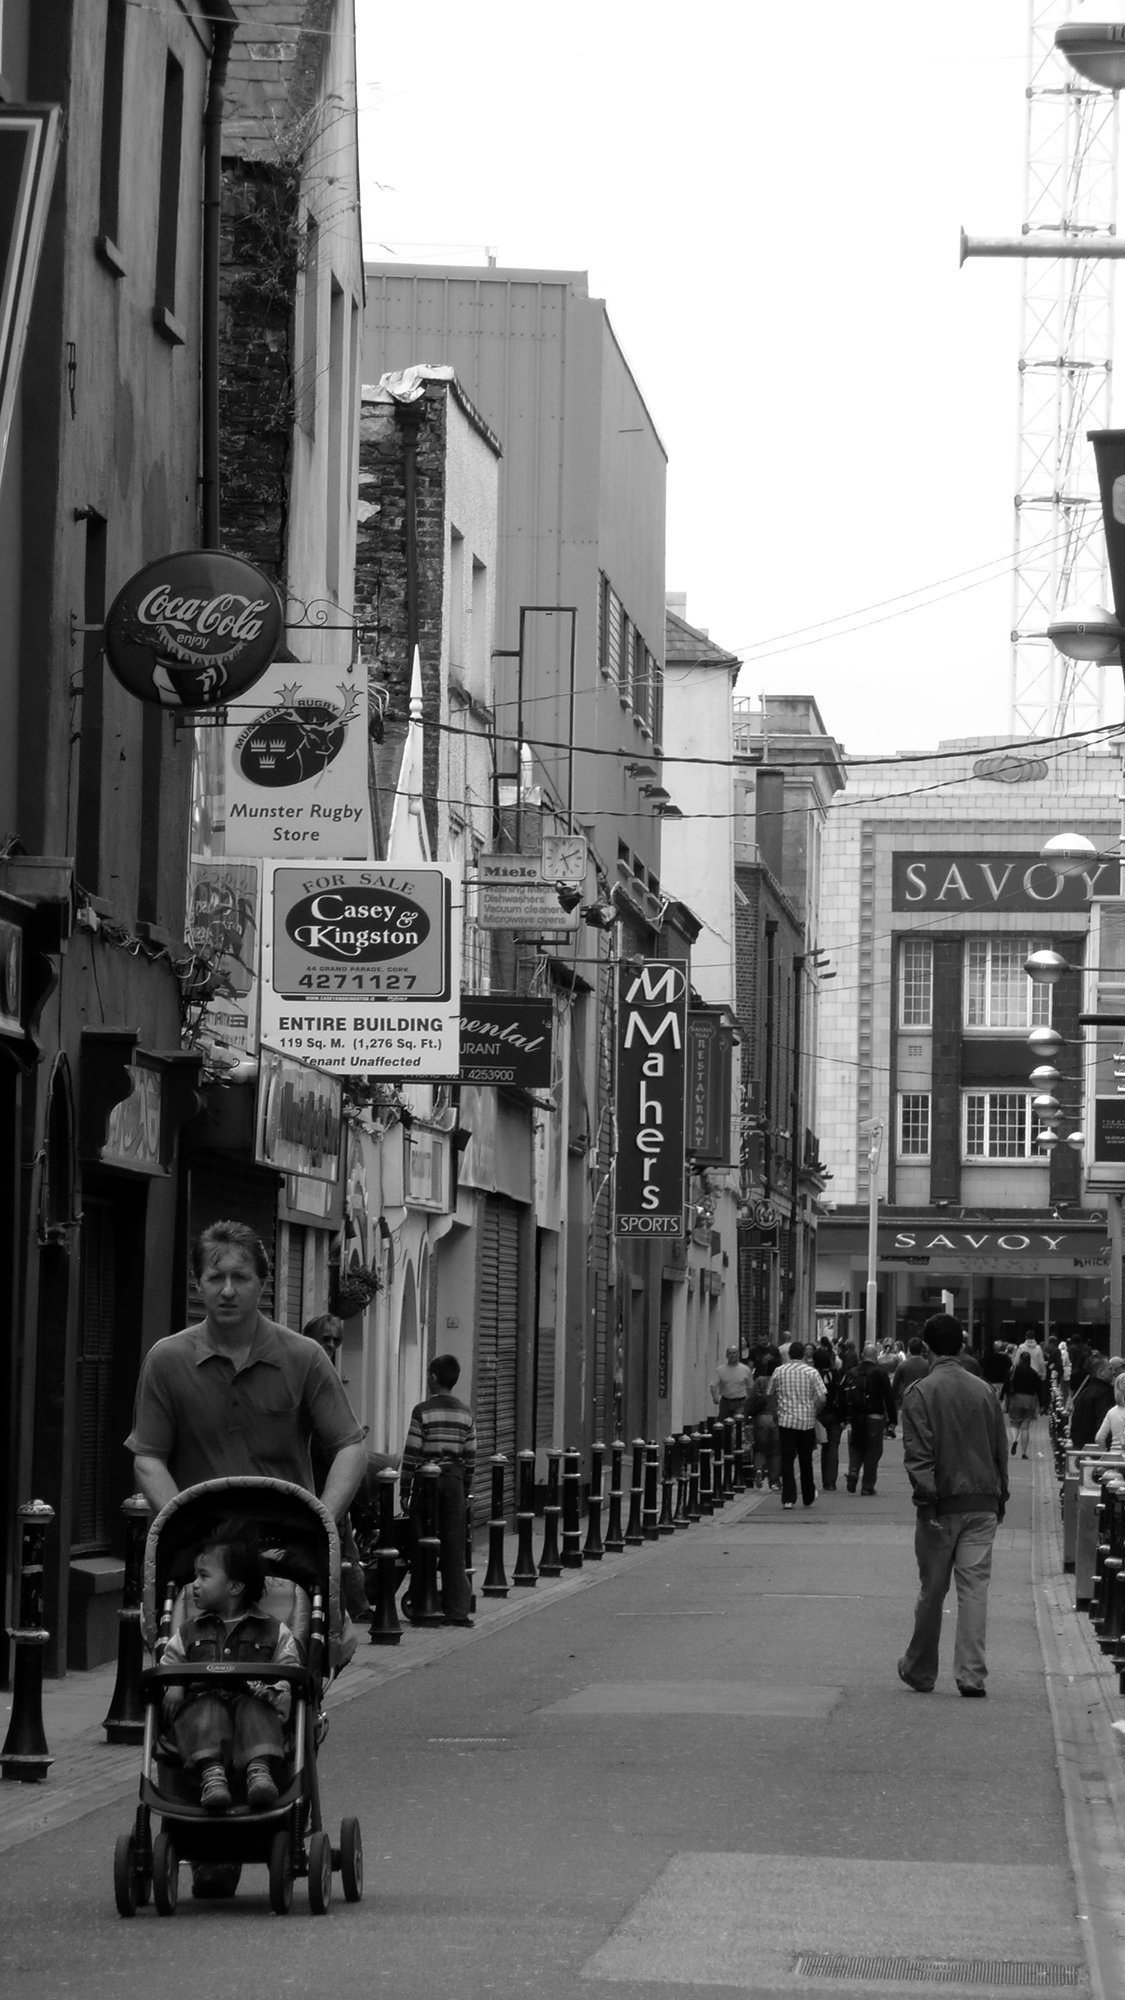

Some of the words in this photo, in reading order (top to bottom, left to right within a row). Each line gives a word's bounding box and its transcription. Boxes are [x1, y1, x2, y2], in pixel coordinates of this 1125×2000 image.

[137, 584, 270, 641] Coca-Cola
[176, 633, 210, 650] enjoy
[298, 700, 340, 713] RUGBY
[234, 707, 281, 750] MUNSTER
[229, 803, 303, 818] Munster
[310, 804, 363, 823] Rugby
[272, 827, 320, 841] Store
[484, 866, 537, 878] Miele
[302, 874, 346, 894] FOR
[359, 873, 415, 895] SALE
[905, 862, 1109, 901] SAVOY
[484, 894, 545, 904] Dishwashers
[311, 894, 396, 922] Casey
[396, 911, 419, 928] &
[484, 904, 522, 913] Vacuum
[484, 915, 536, 924] Microwave
[294, 925, 419, 956] Kingston
[298, 974, 417, 990] 4271127
[279, 1017, 347, 1031] ENTIRE
[353, 1018, 443, 1032] BUILDING
[280, 1038, 302, 1048] 119
[306, 1038, 326, 1050] Sq.
[330, 1039, 345, 1048] M.
[352, 1038, 393, 1051] (1,276
[396, 1039, 417, 1051] Sq.
[420, 1039, 442, 1050] Ft.)
[302, 1056, 346, 1067] Tenant
[350, 1056, 421, 1067] Unaffected
[468, 1070, 514, 1081] 4253900
[624, 1010, 681, 1210] Mahers
[620, 1217, 679, 1233] SPORTS
[895, 1233, 1067, 1250] SAVOY
